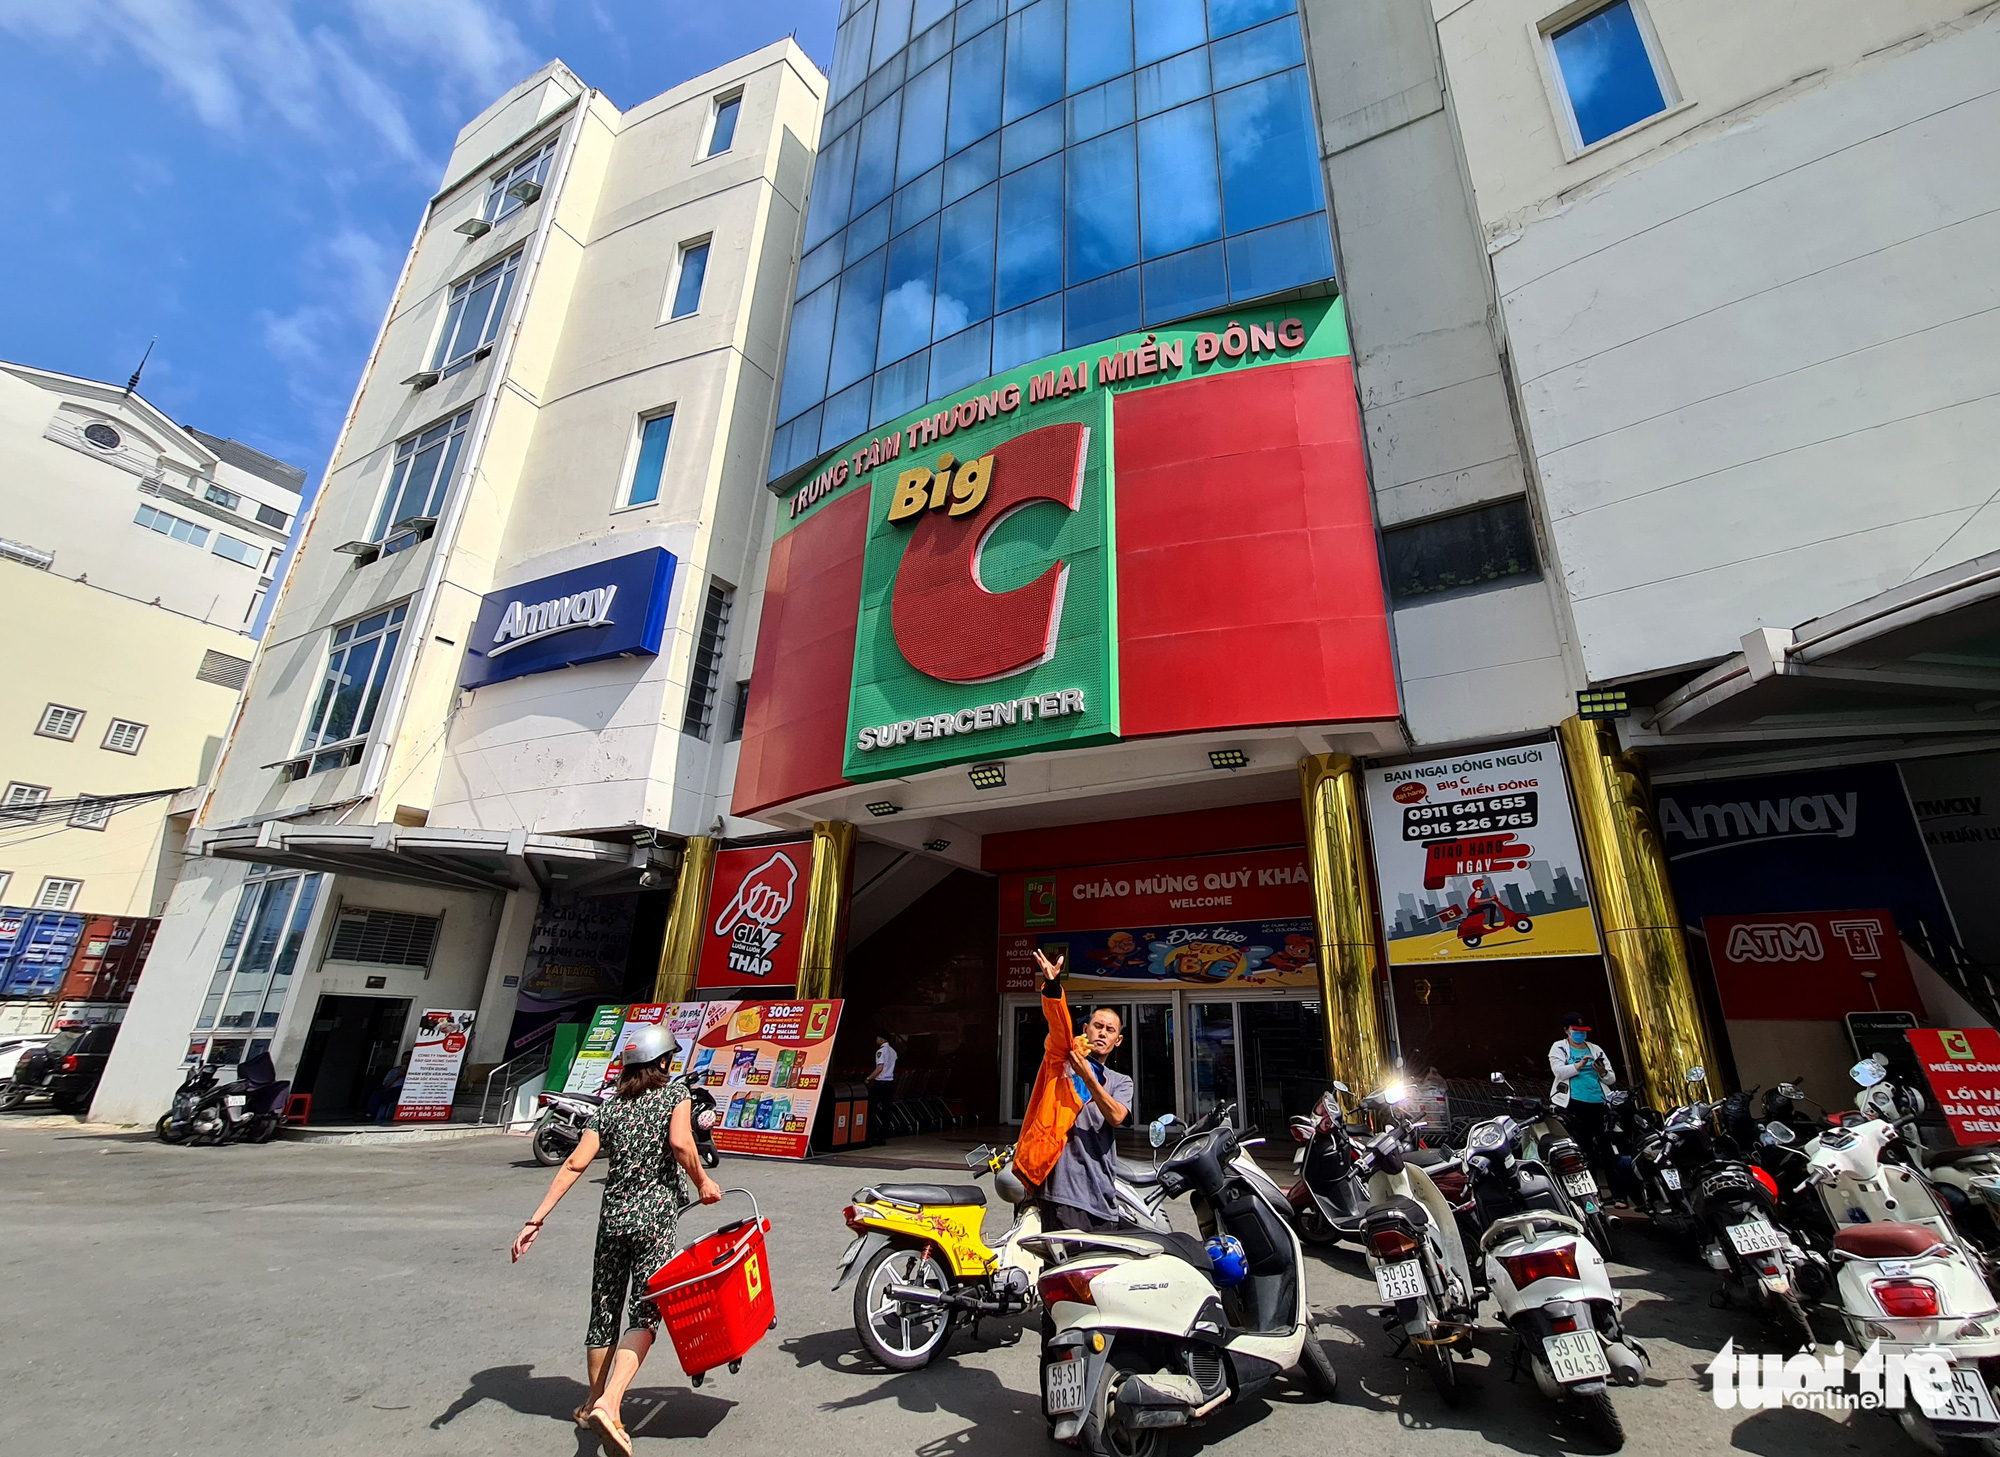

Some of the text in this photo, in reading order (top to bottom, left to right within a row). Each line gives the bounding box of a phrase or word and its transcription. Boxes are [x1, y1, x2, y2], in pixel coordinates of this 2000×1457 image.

[789, 317, 1305, 519] TRUNG TÂM THƯƠNG MẠI MIỀN ĐÔNG
[888, 452, 996, 527] Big
[493, 585, 618, 644] Amway
[857, 687, 1086, 753] SUPERCENTER
[1384, 750, 1543, 783] BẠN NGẠI ĐÔNG NGƯỜI
[1460, 776, 1470, 785] C
[1498, 778, 1539, 791] ĐÔNG
[1408, 796, 1527, 820] 0911 641 655
[1658, 791, 1858, 840] Amway
[1407, 812, 1533, 837] 0916 226 765
[1457, 858, 1492, 874] NGAY
[1072, 862, 1310, 900] CHÀO MỪNG QUÝ KHÁ
[1169, 895, 1233, 909] WELCOME
[735, 921, 766, 945] GIÁ
[1166, 927, 1249, 945] Đại tiệc
[1728, 925, 1821, 960] ATM
[1009, 966, 1031, 975] 7H30
[1006, 980, 1034, 988] 22H00
[763, 1023, 777, 1034] 05
[1946, 1086, 1978, 1100] LỐI
[1736, 1235, 1777, 1252] 236.96
[1382, 1263, 1415, 1282] 50-03
[1386, 1279, 1419, 1298] 2536
[1551, 1334, 1591, 1357] 59-U1
[1052, 1362, 1077, 1387] 59-S1
[1555, 1353, 1605, 1379] 194.53
[1050, 1385, 1082, 1410] 888.37
